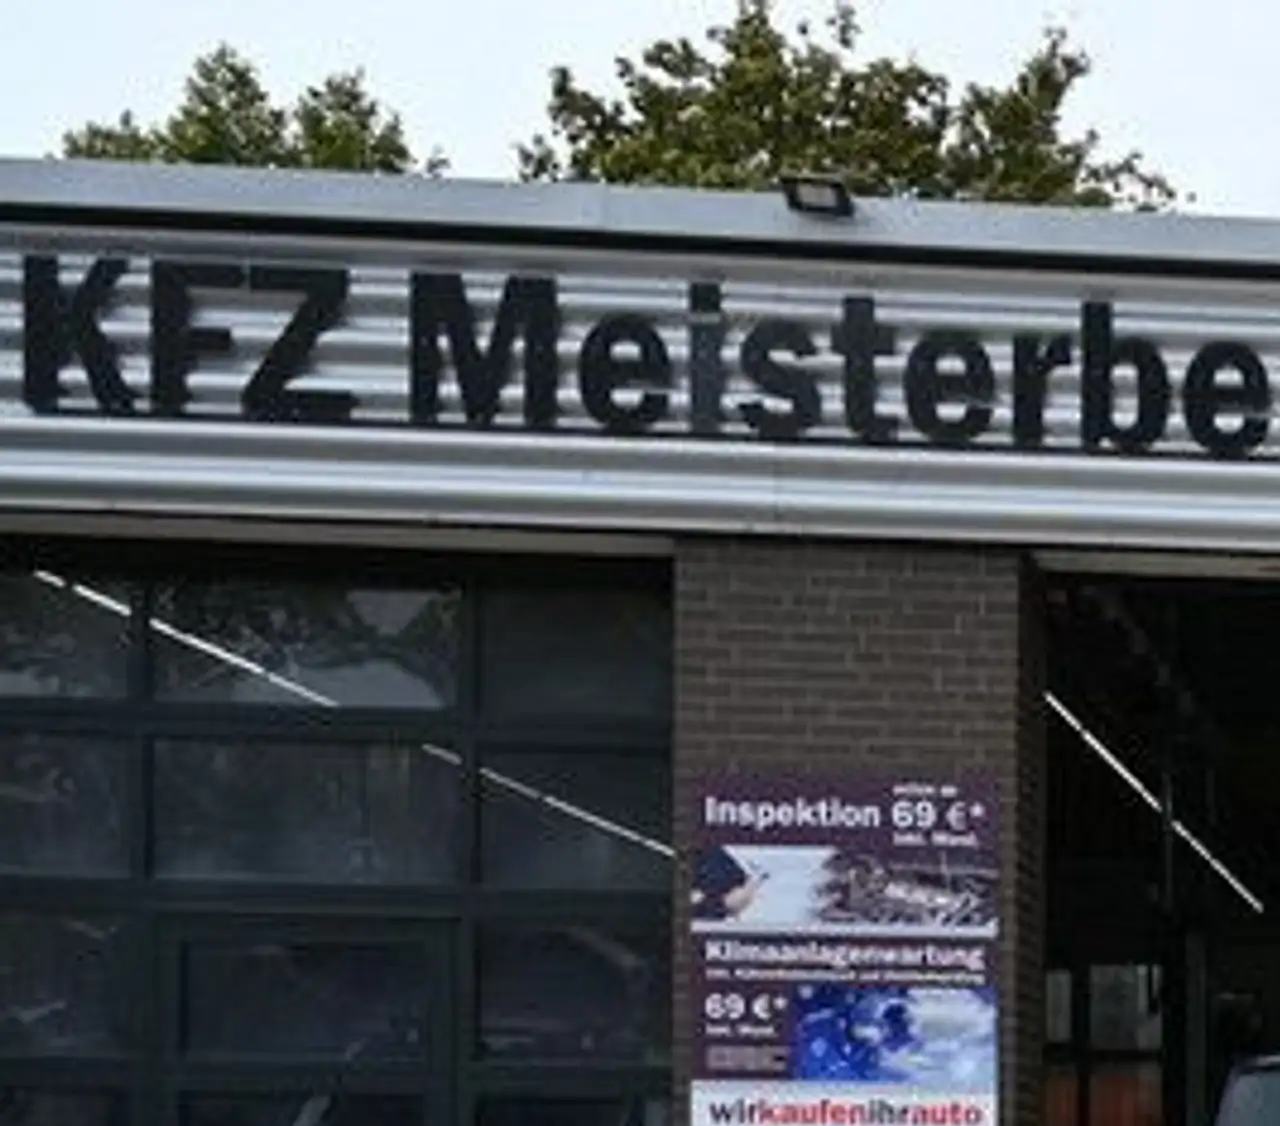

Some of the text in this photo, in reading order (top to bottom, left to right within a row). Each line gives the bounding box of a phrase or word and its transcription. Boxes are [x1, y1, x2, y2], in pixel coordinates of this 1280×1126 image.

[22, 254, 360, 420] KFZ
[704, 796, 881, 831] Inspektion
[891, 800, 936, 829] 69
[704, 940, 987, 972] Klimaanlagenwartung
[704, 992, 746, 1020] 69
[709, 1098, 985, 1126] wirkaufenihrauto
